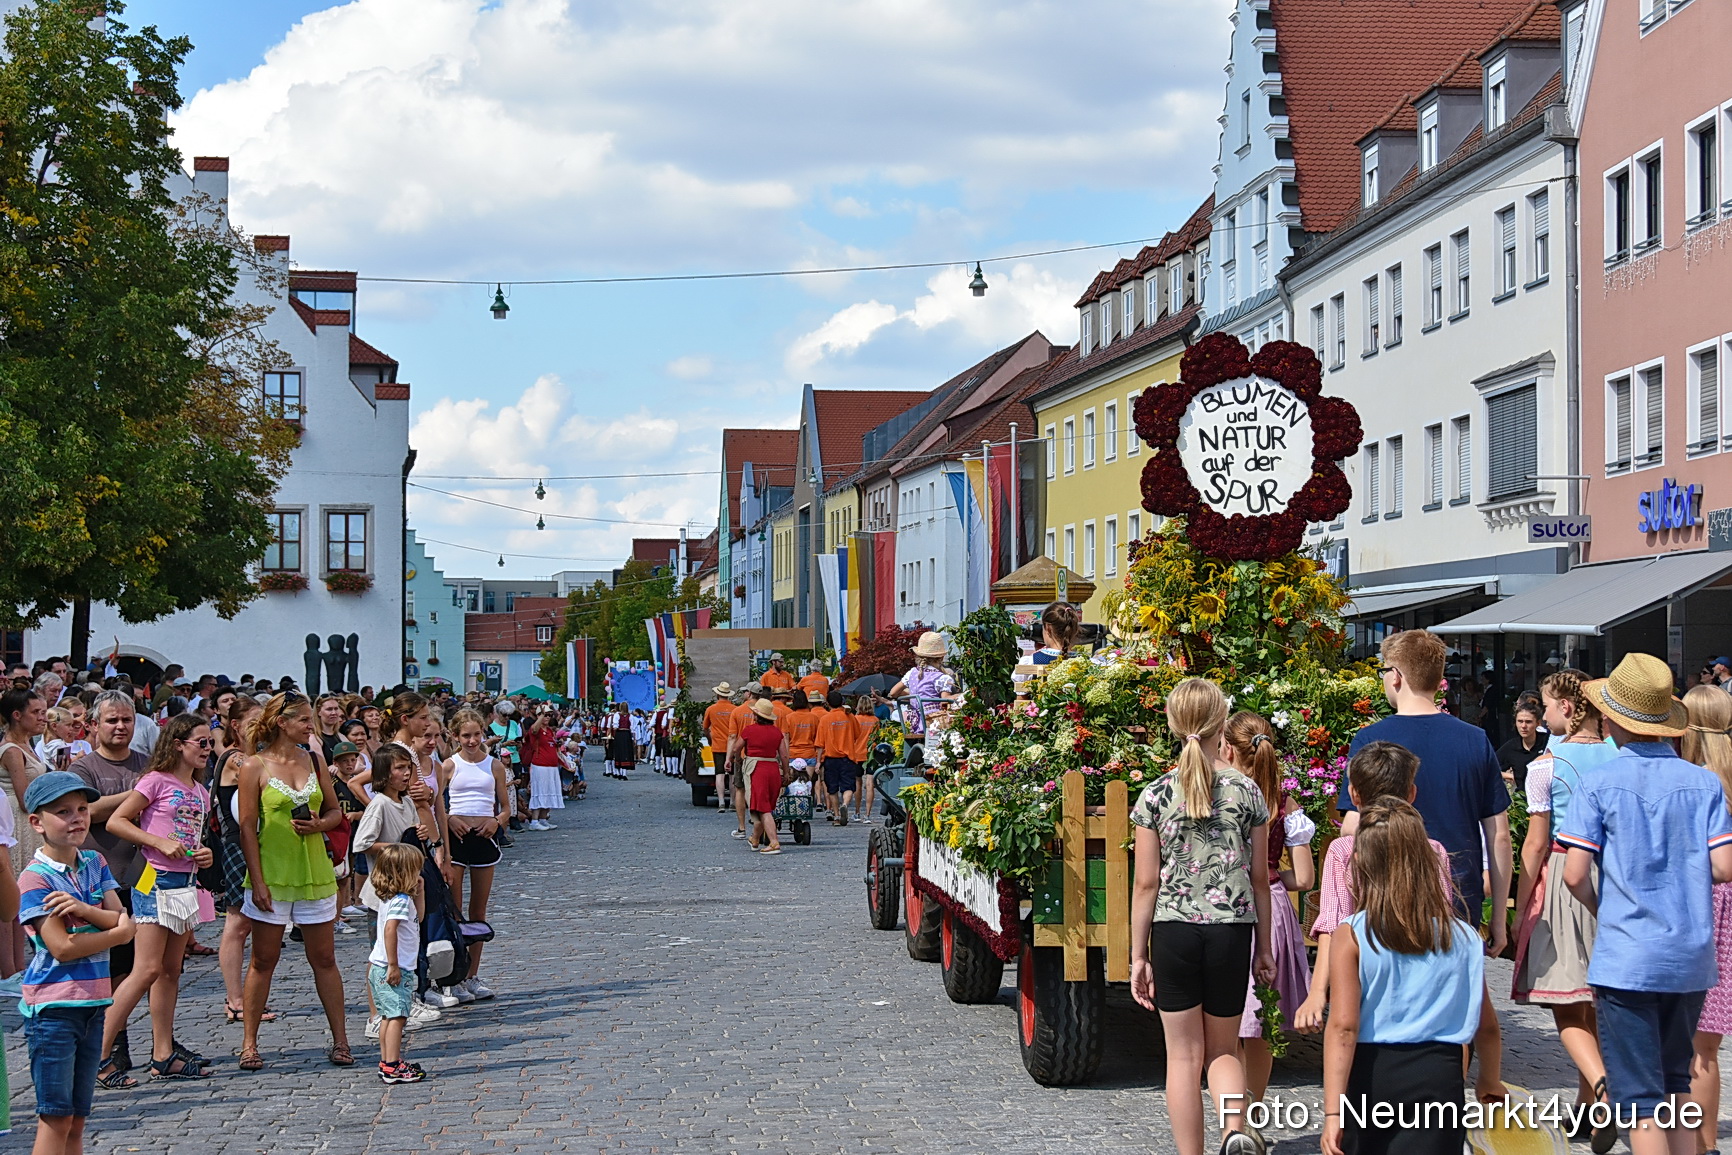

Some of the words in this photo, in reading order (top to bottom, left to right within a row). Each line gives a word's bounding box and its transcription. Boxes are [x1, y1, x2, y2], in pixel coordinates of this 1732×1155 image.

[1200, 382, 1307, 428] BLUMEN
[1226, 406, 1258, 424] und
[1199, 425, 1287, 452] NATUR
[1201, 453, 1235, 476] auf
[1244, 449, 1282, 471] der
[1204, 473, 1286, 513] SPUR
